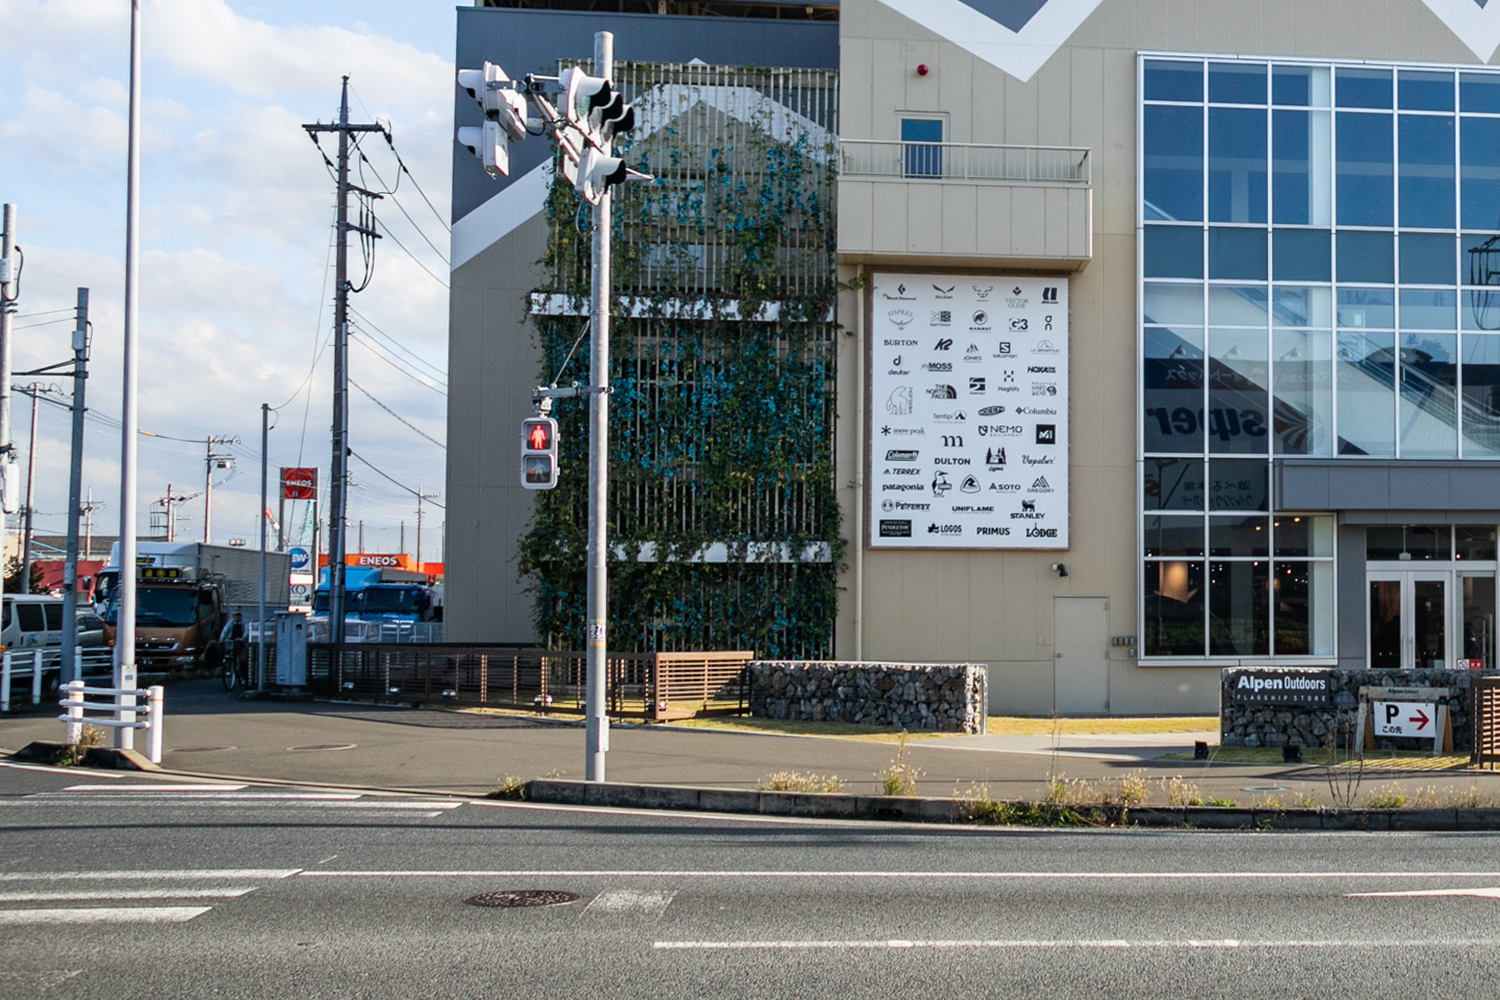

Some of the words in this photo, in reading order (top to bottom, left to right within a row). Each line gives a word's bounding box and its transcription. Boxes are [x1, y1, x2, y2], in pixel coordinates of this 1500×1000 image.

[888, 309, 914, 317] OSPREY
[934, 338, 953, 351] K2
[928, 362, 953, 370] MOSS
[1022, 407, 1057, 415] Columbia
[910, 427, 925, 435] peak
[990, 425, 1023, 433] NEMO
[882, 483, 924, 491] patagonia
[940, 525, 962, 533] LOGOS
[976, 527, 1011, 536] PRIMUS
[1026, 528, 1058, 538] LODGE
[359, 556, 398, 566] ENEOS
[1238, 675, 1283, 692] Alpen
[1284, 676, 1326, 690] Outdoors
[1385, 704, 1400, 724] P
[1382, 725, 1403, 734] この先
